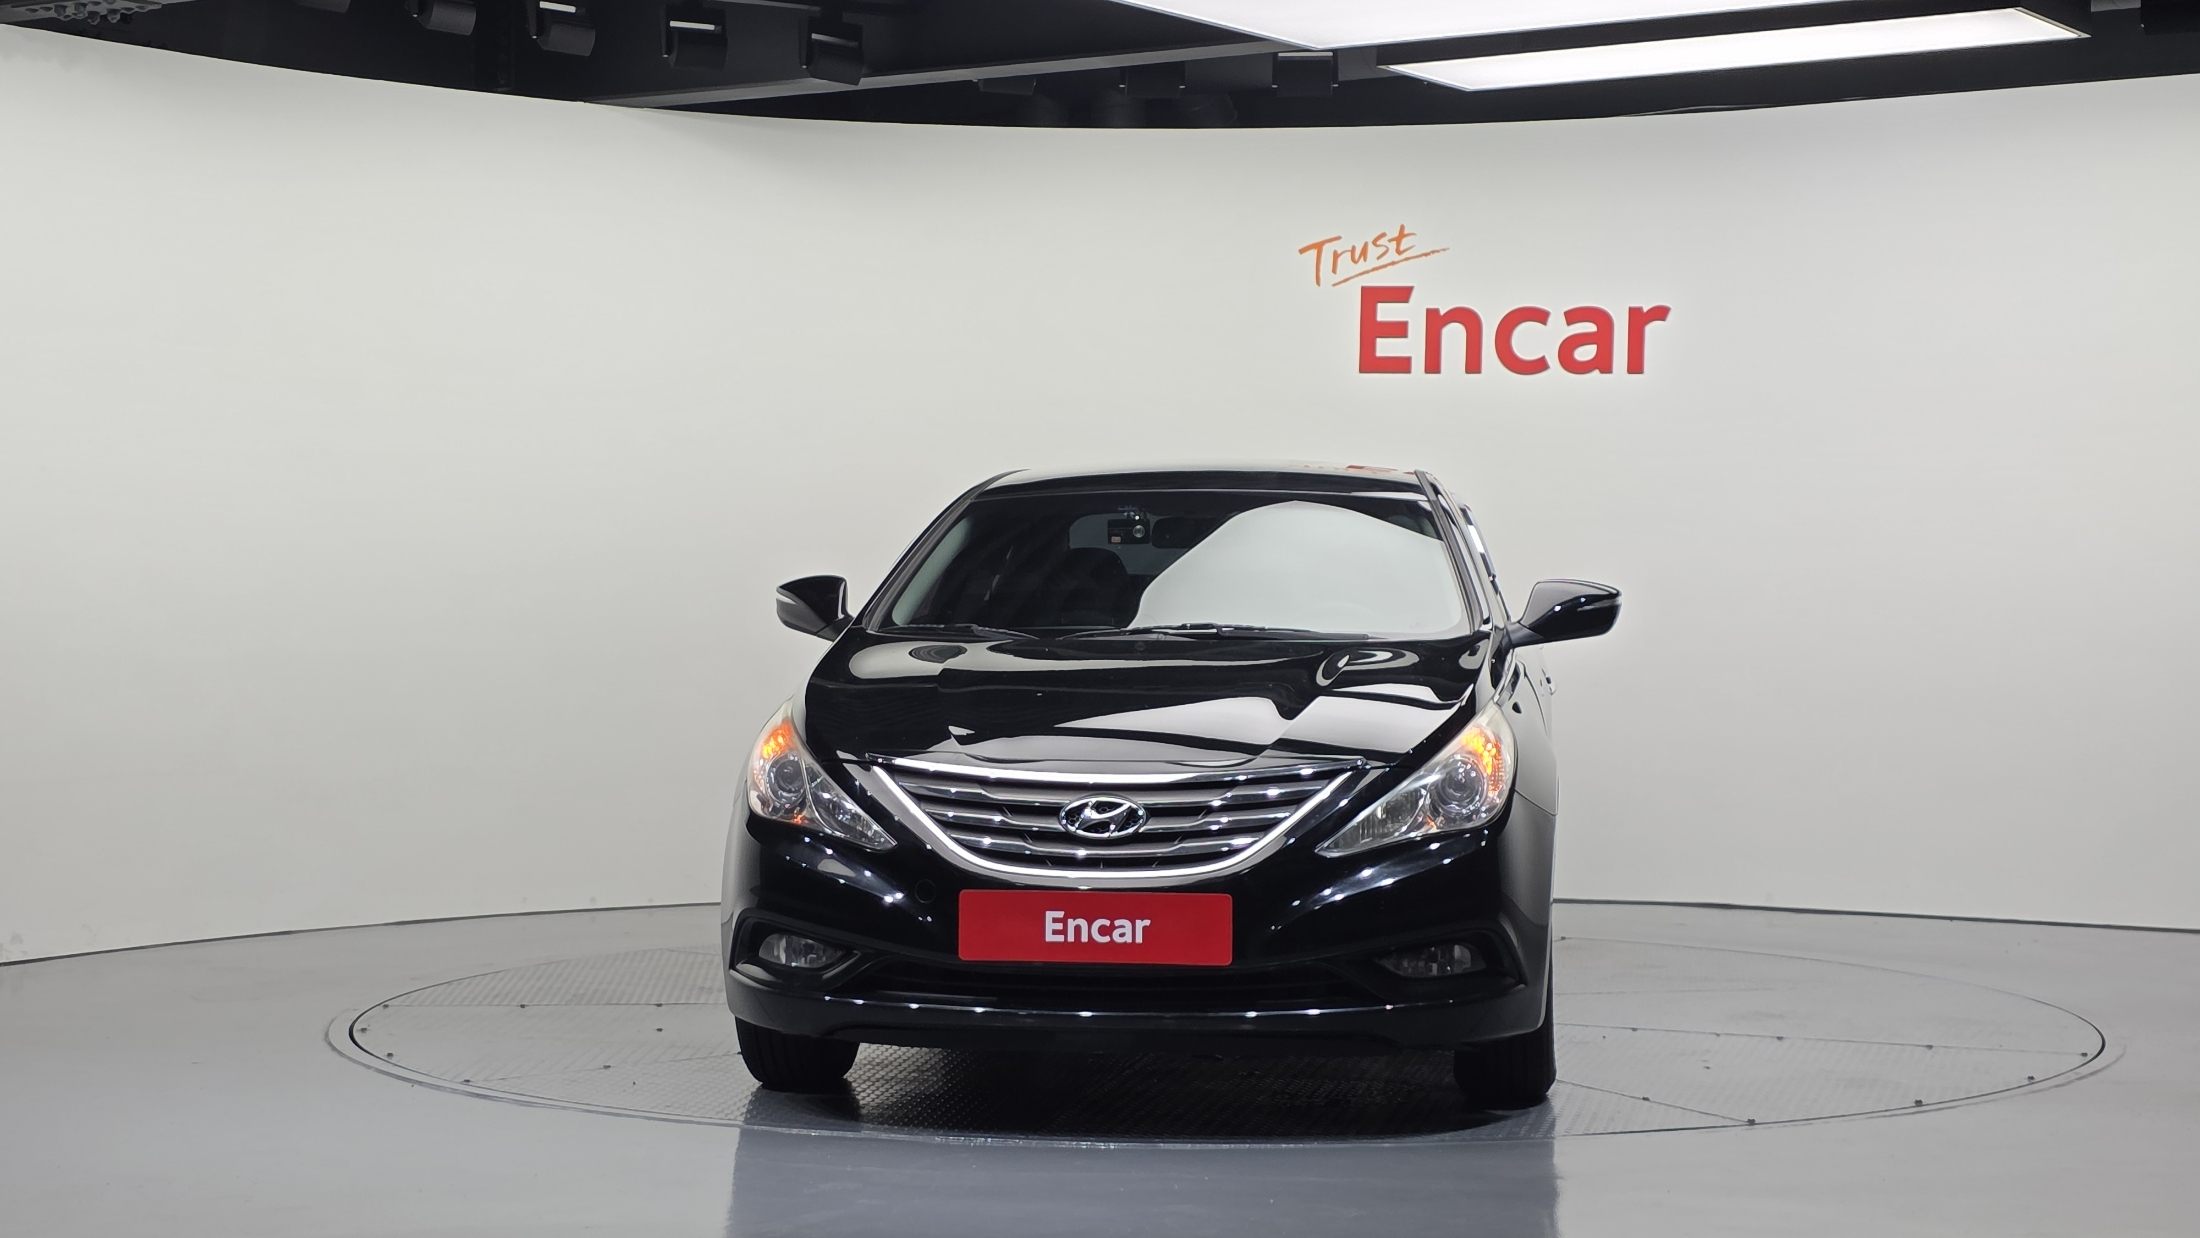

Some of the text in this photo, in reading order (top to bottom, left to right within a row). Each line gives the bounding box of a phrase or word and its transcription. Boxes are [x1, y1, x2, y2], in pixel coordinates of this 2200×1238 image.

[1299, 224, 1418, 287] Trust
[1358, 285, 1672, 375] Encar
[1044, 910, 1151, 944] Encar
